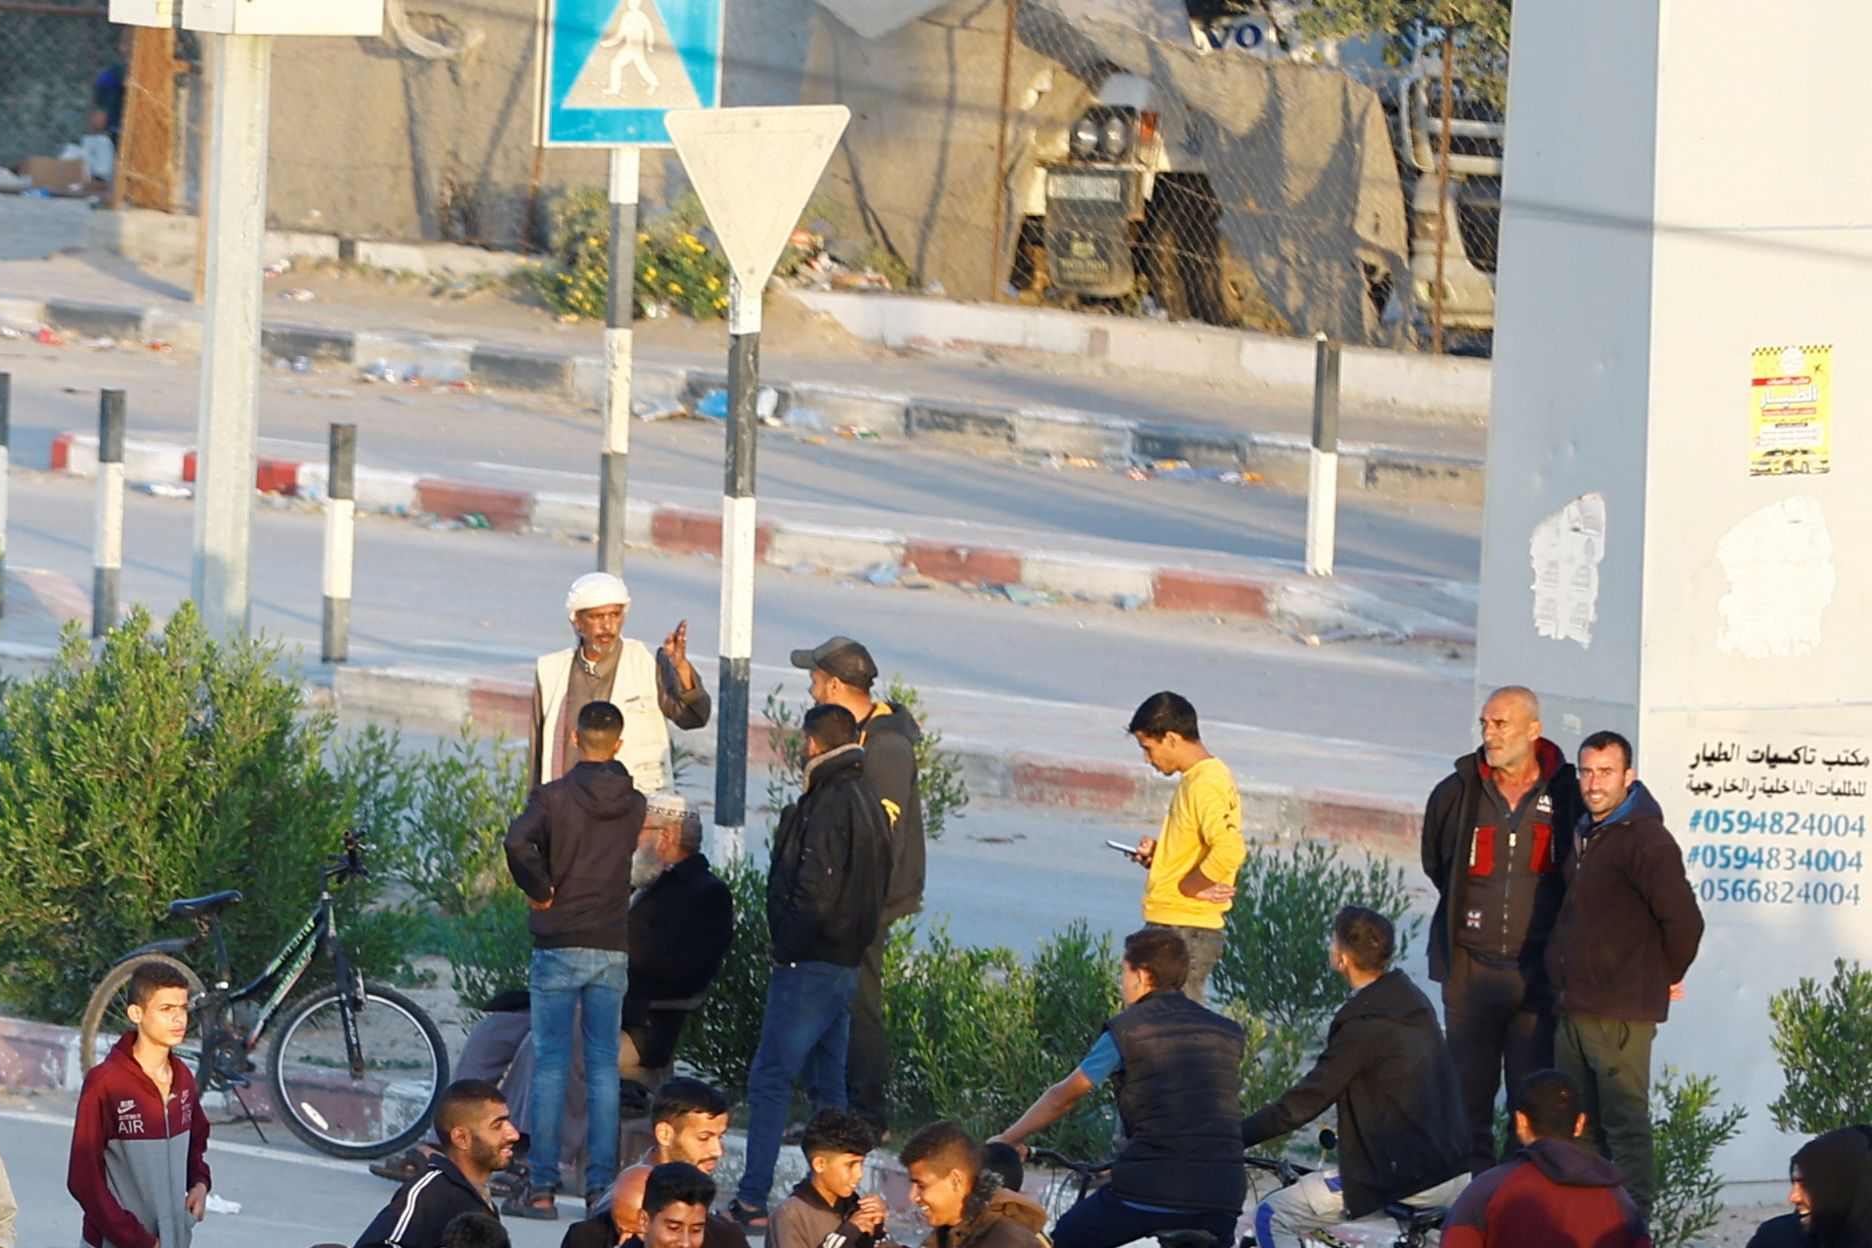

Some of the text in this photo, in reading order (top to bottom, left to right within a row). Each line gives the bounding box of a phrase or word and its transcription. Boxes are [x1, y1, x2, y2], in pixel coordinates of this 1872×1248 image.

[1689, 741, 1870, 772] مكتب تاكسيات الطيار
[1689, 809, 1866, 839] #0594824004
[1687, 844, 1863, 873] #0594834004
[1692, 878, 1861, 906] 0566824004
[118, 1119, 145, 1134] AIR
